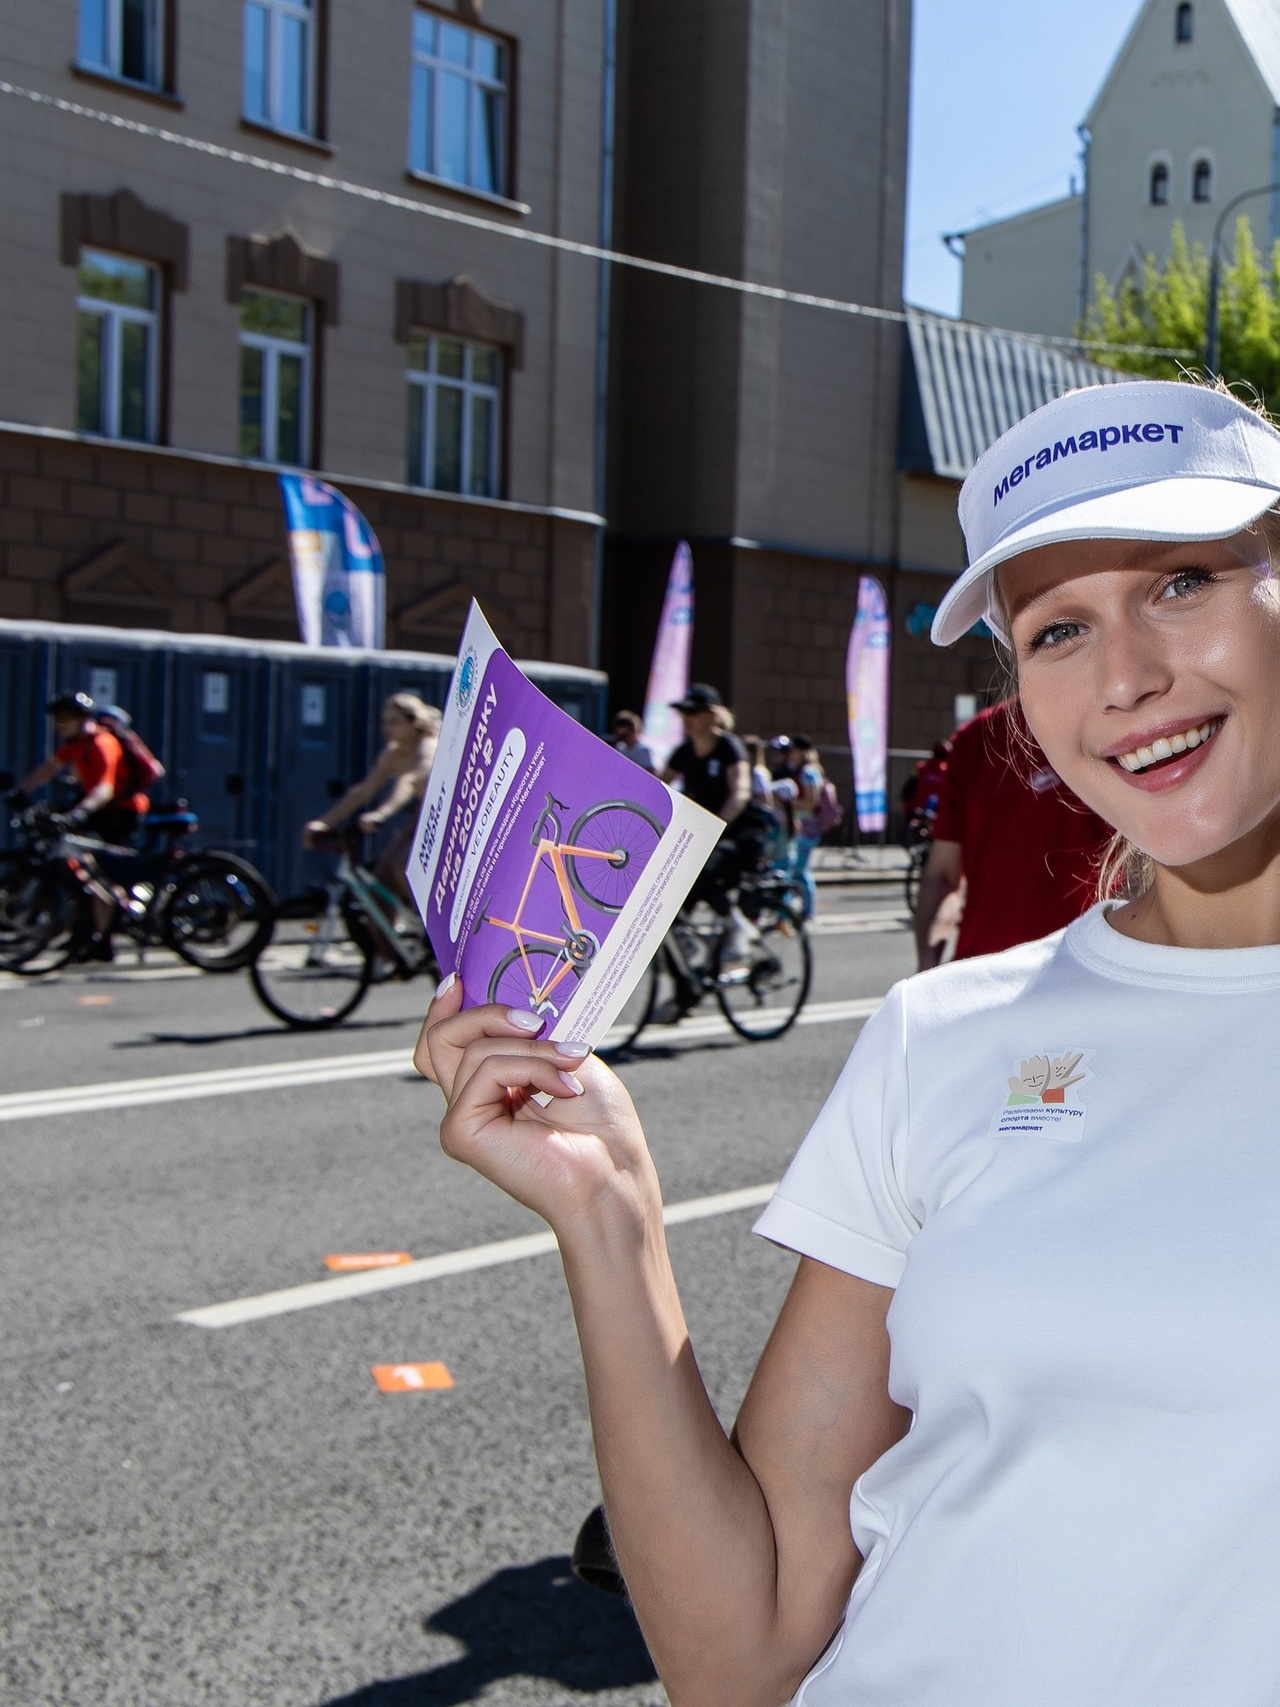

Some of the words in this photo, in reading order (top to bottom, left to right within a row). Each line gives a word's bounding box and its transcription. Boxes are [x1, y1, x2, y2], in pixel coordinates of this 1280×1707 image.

[994, 423, 1184, 507] мегамаркет
[435, 804, 463, 915] Дарим
[461, 682, 498, 800] скидку
[471, 746, 514, 856] VELOBEAUTY
[520, 756, 546, 805] Мегамаркет
[419, 804, 436, 866] мега
[422, 781, 447, 874] маркет
[450, 853, 461, 893] на
[459, 767, 485, 852] 2000
[497, 809, 512, 839] раздел
[1003, 1108, 1044, 1116] Развиваем
[1045, 1108, 1083, 1117] культуру
